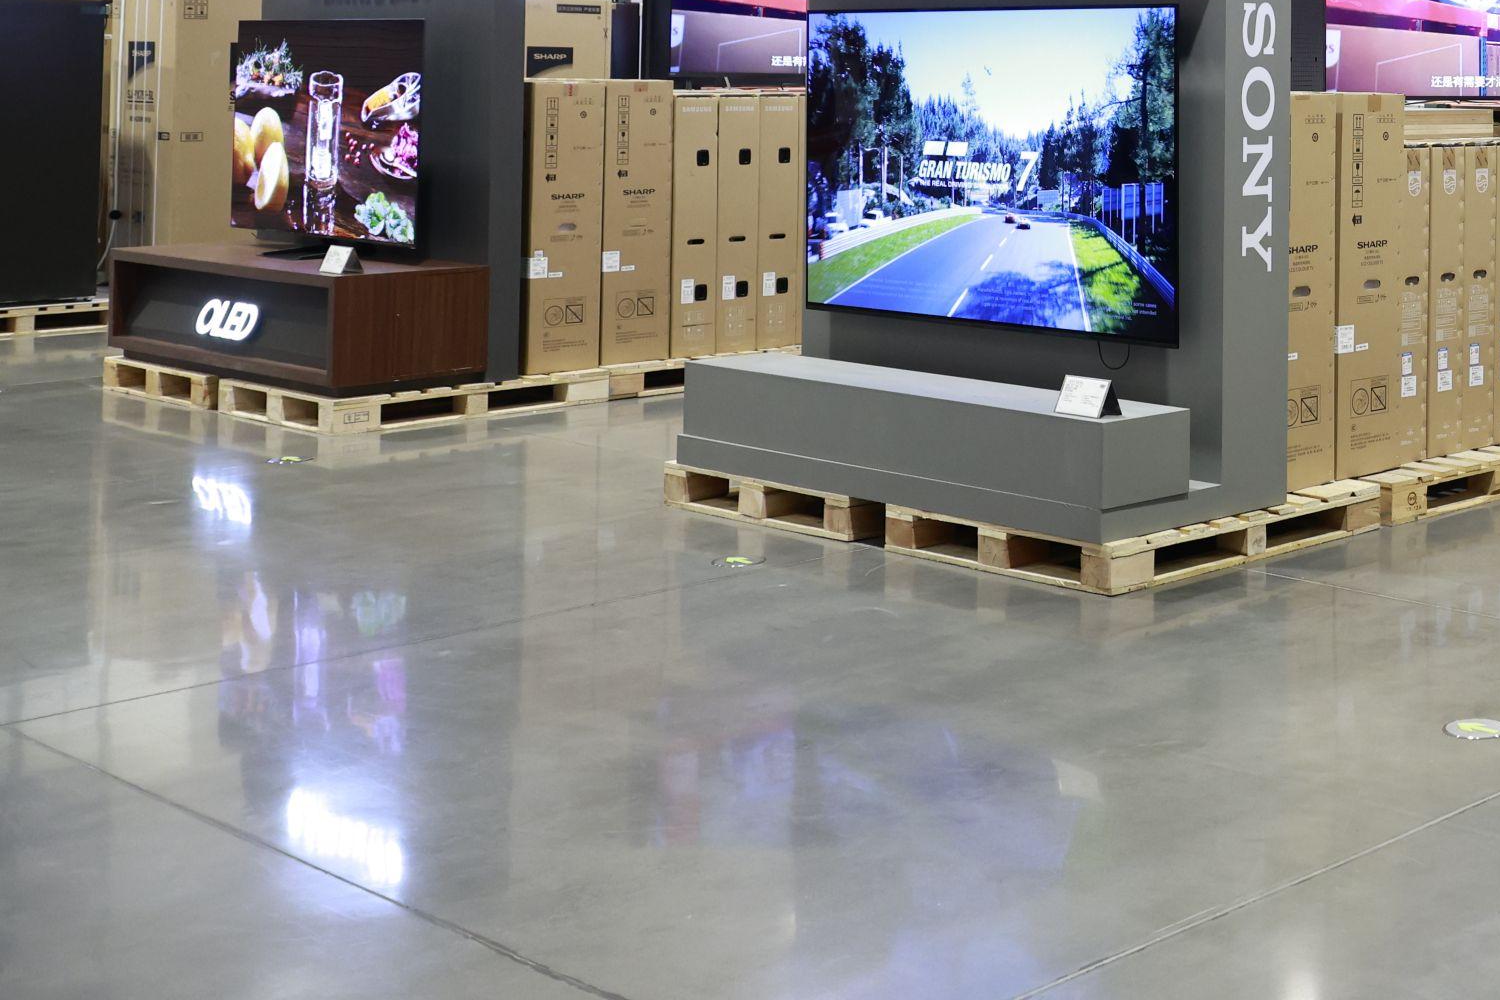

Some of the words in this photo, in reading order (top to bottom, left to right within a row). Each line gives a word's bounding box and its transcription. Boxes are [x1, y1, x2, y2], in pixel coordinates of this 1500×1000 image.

[682, 105, 712, 113] SAMSUNG
[1241, 2, 1276, 272] SONY
[919, 159, 953, 179] GRAN
[955, 161, 1012, 181] TURISMO
[1016, 151, 1040, 192] 7
[551, 192, 585, 201] SHARP
[622, 188, 656, 196] SHARP
[1288, 244, 1319, 255] SHARP
[1357, 239, 1388, 250] SHARP
[195, 298, 259, 341] OLED
